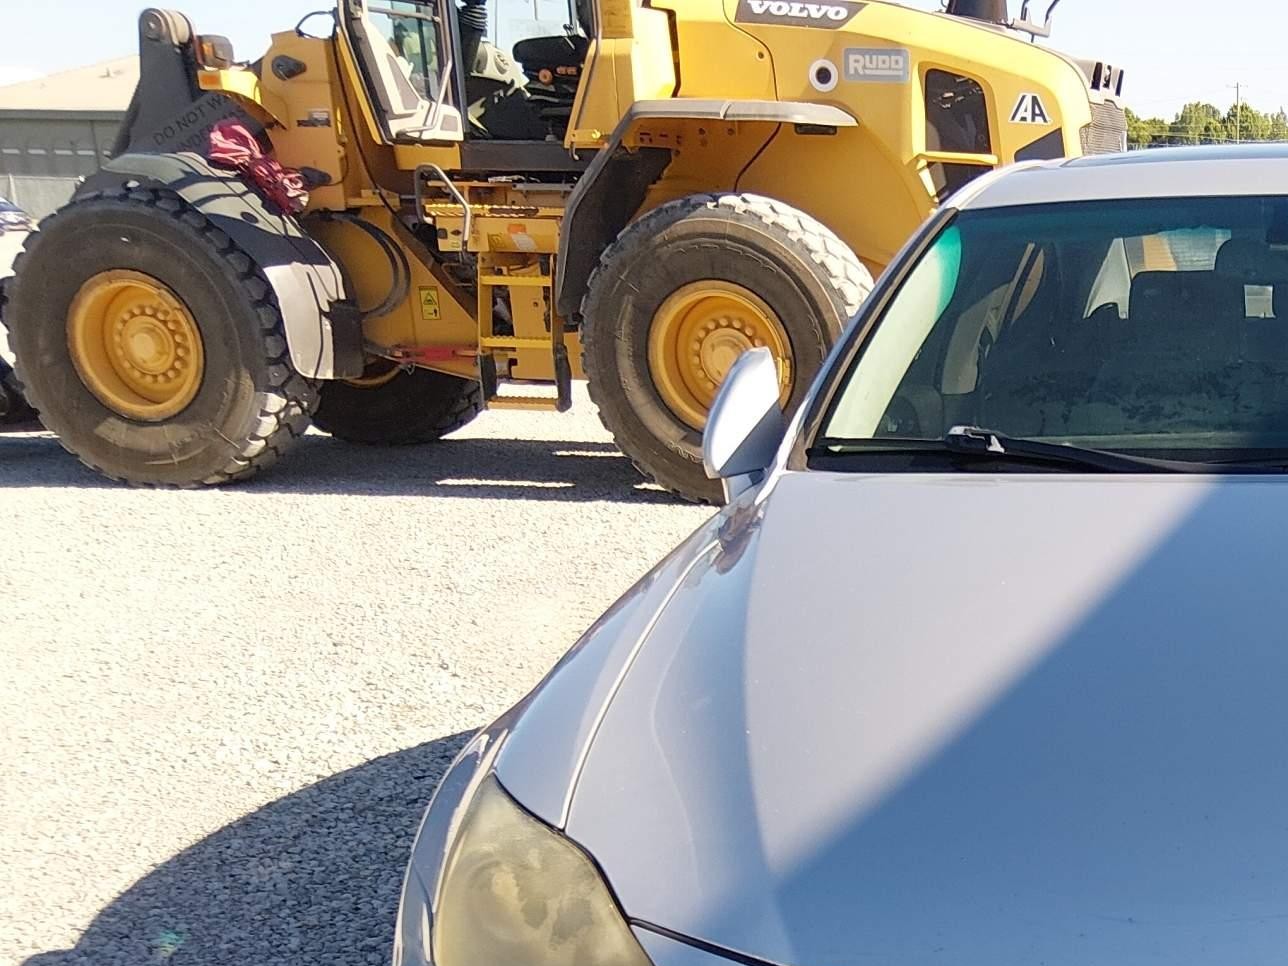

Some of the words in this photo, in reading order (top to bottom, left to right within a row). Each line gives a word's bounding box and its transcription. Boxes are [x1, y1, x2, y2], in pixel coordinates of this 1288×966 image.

[747, 0, 848, 21] VOLVO
[849, 54, 904, 75] RUDD
[153, 126, 176, 146] DO
[176, 106, 206, 130] NOT
